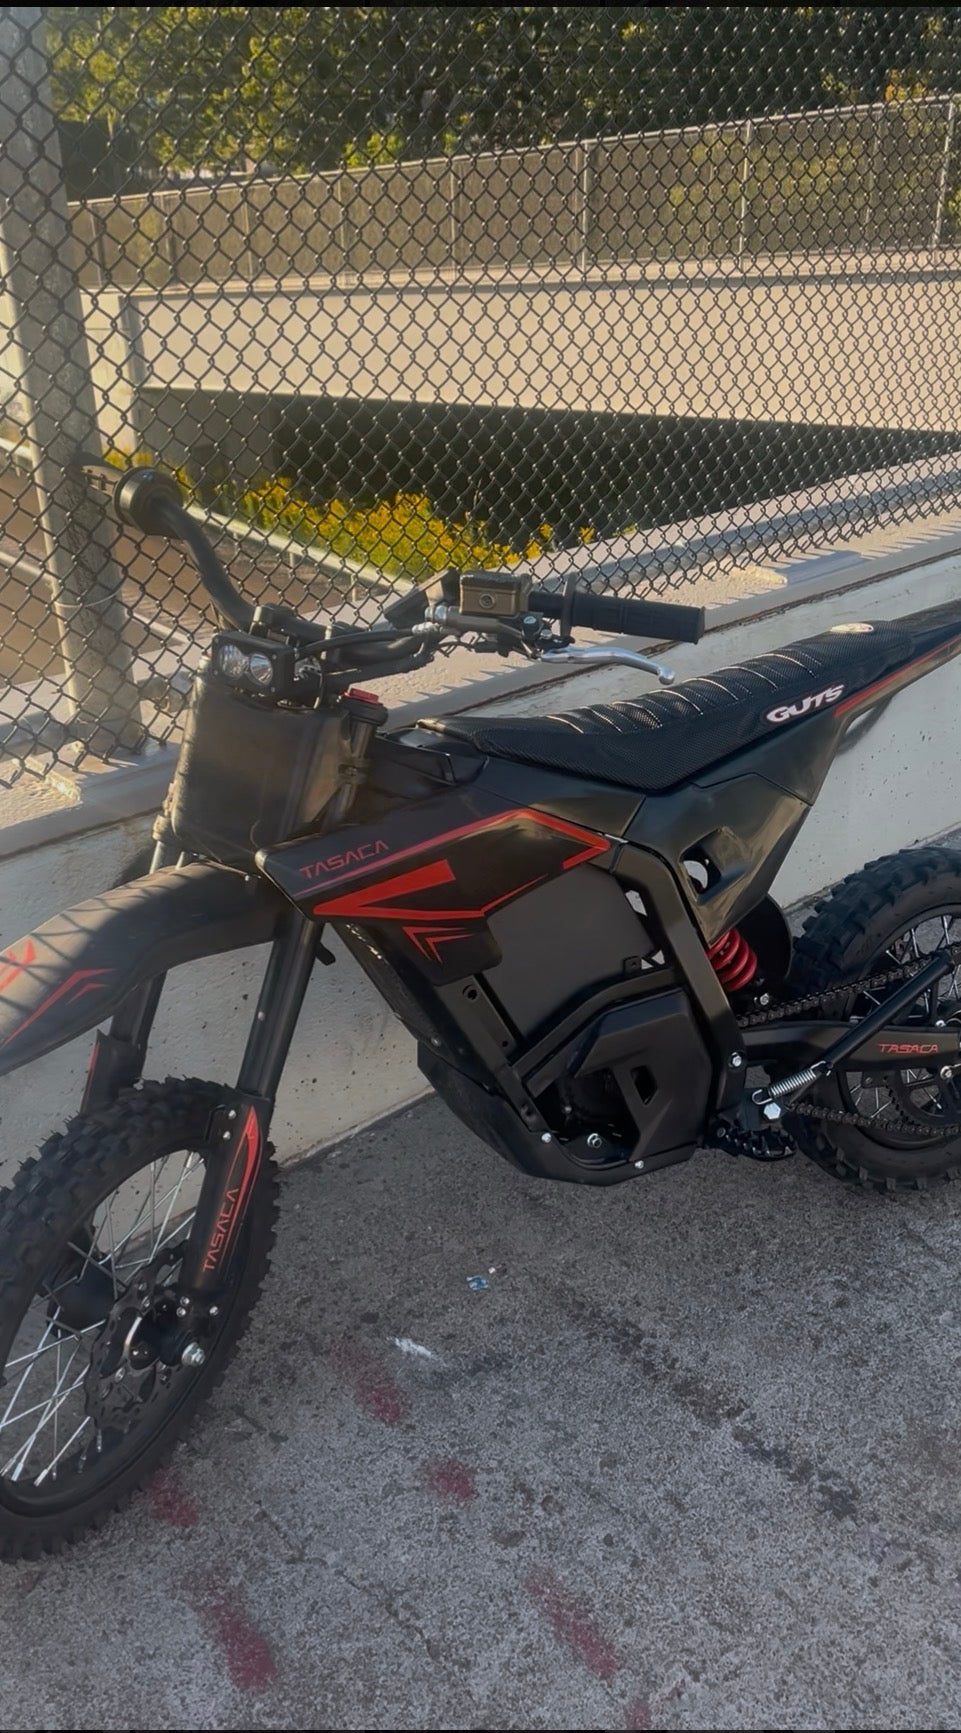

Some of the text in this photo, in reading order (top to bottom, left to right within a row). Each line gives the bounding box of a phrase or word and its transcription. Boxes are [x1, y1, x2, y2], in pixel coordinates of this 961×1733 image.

[766, 684, 845, 722] GUTS
[299, 839, 390, 879] TASACA
[878, 1043, 939, 1054] TASACA
[202, 1188, 239, 1272] TASACA
